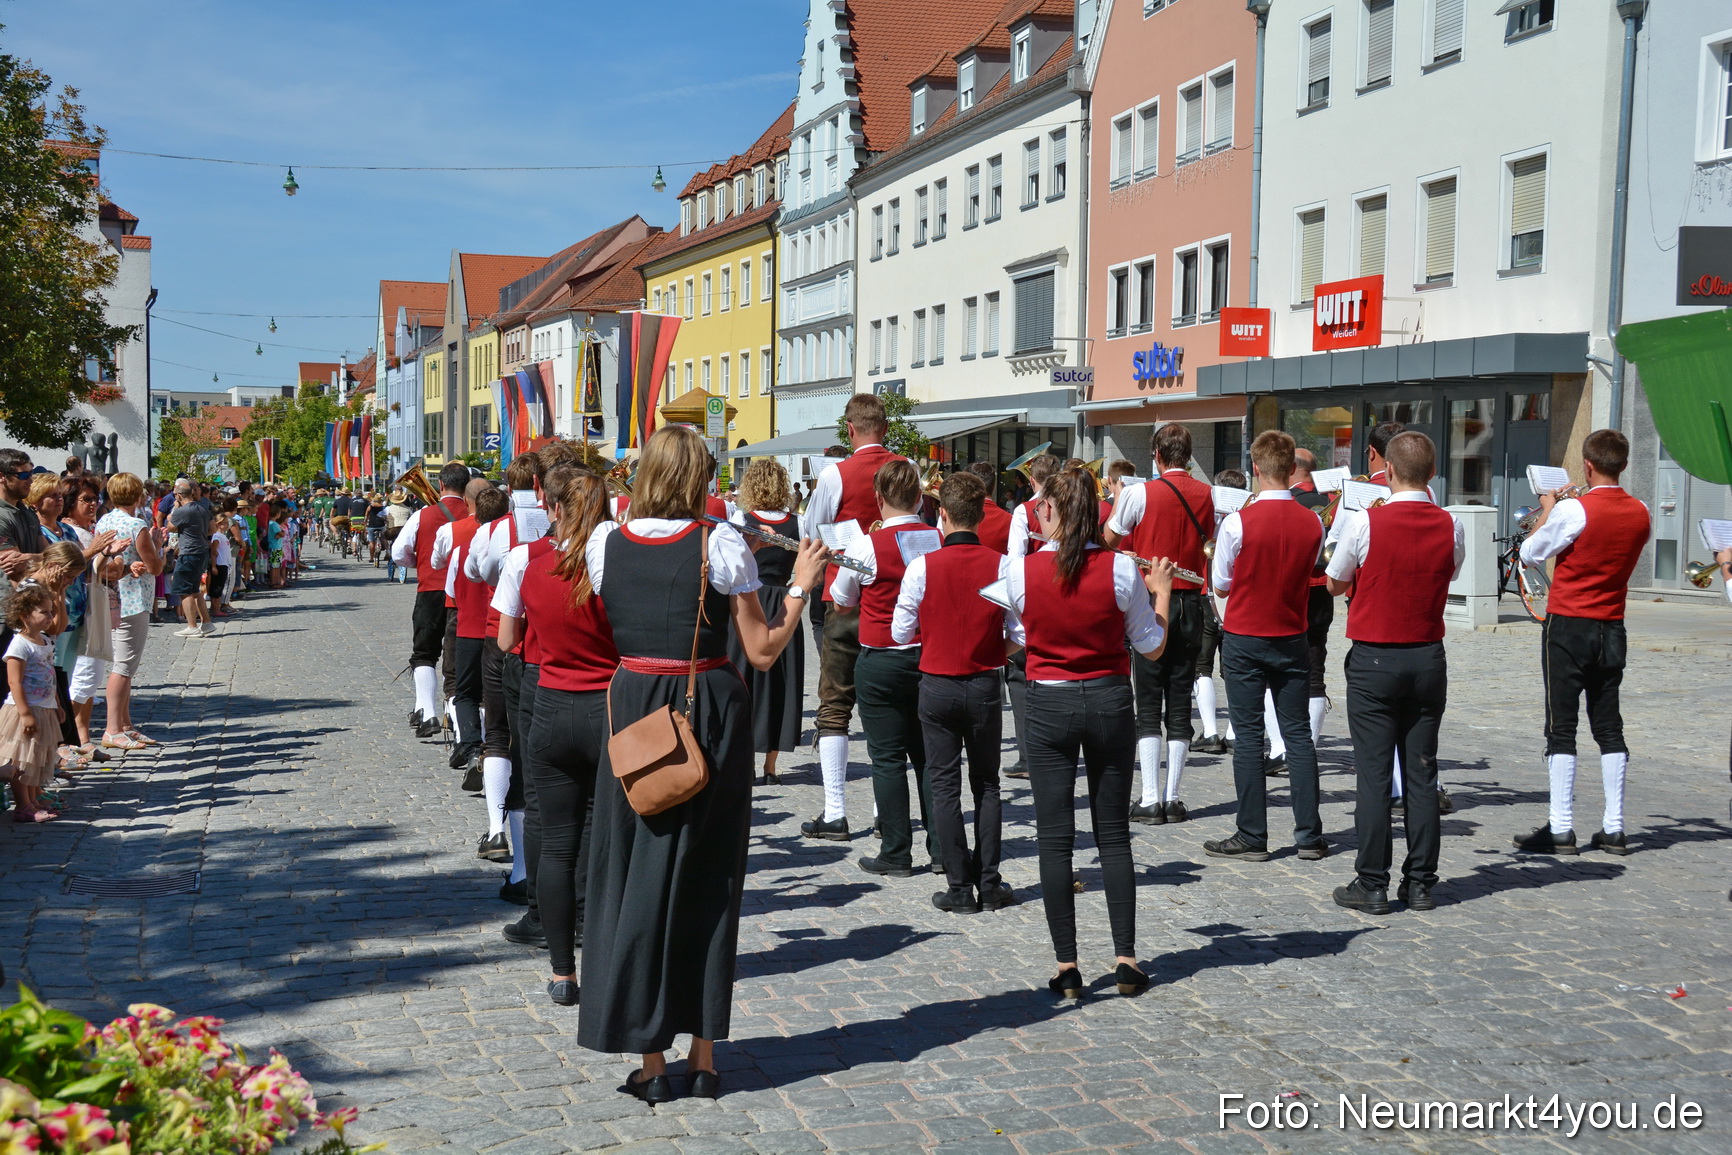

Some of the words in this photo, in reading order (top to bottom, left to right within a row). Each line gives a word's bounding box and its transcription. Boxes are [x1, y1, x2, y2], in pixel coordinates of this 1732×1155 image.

[1316, 290, 1363, 327] WITT
[1231, 324, 1263, 337] WITT
[1332, 327, 1357, 339] weiden
[1053, 369, 1093, 383] sutor.
[711, 401, 720, 411] H
